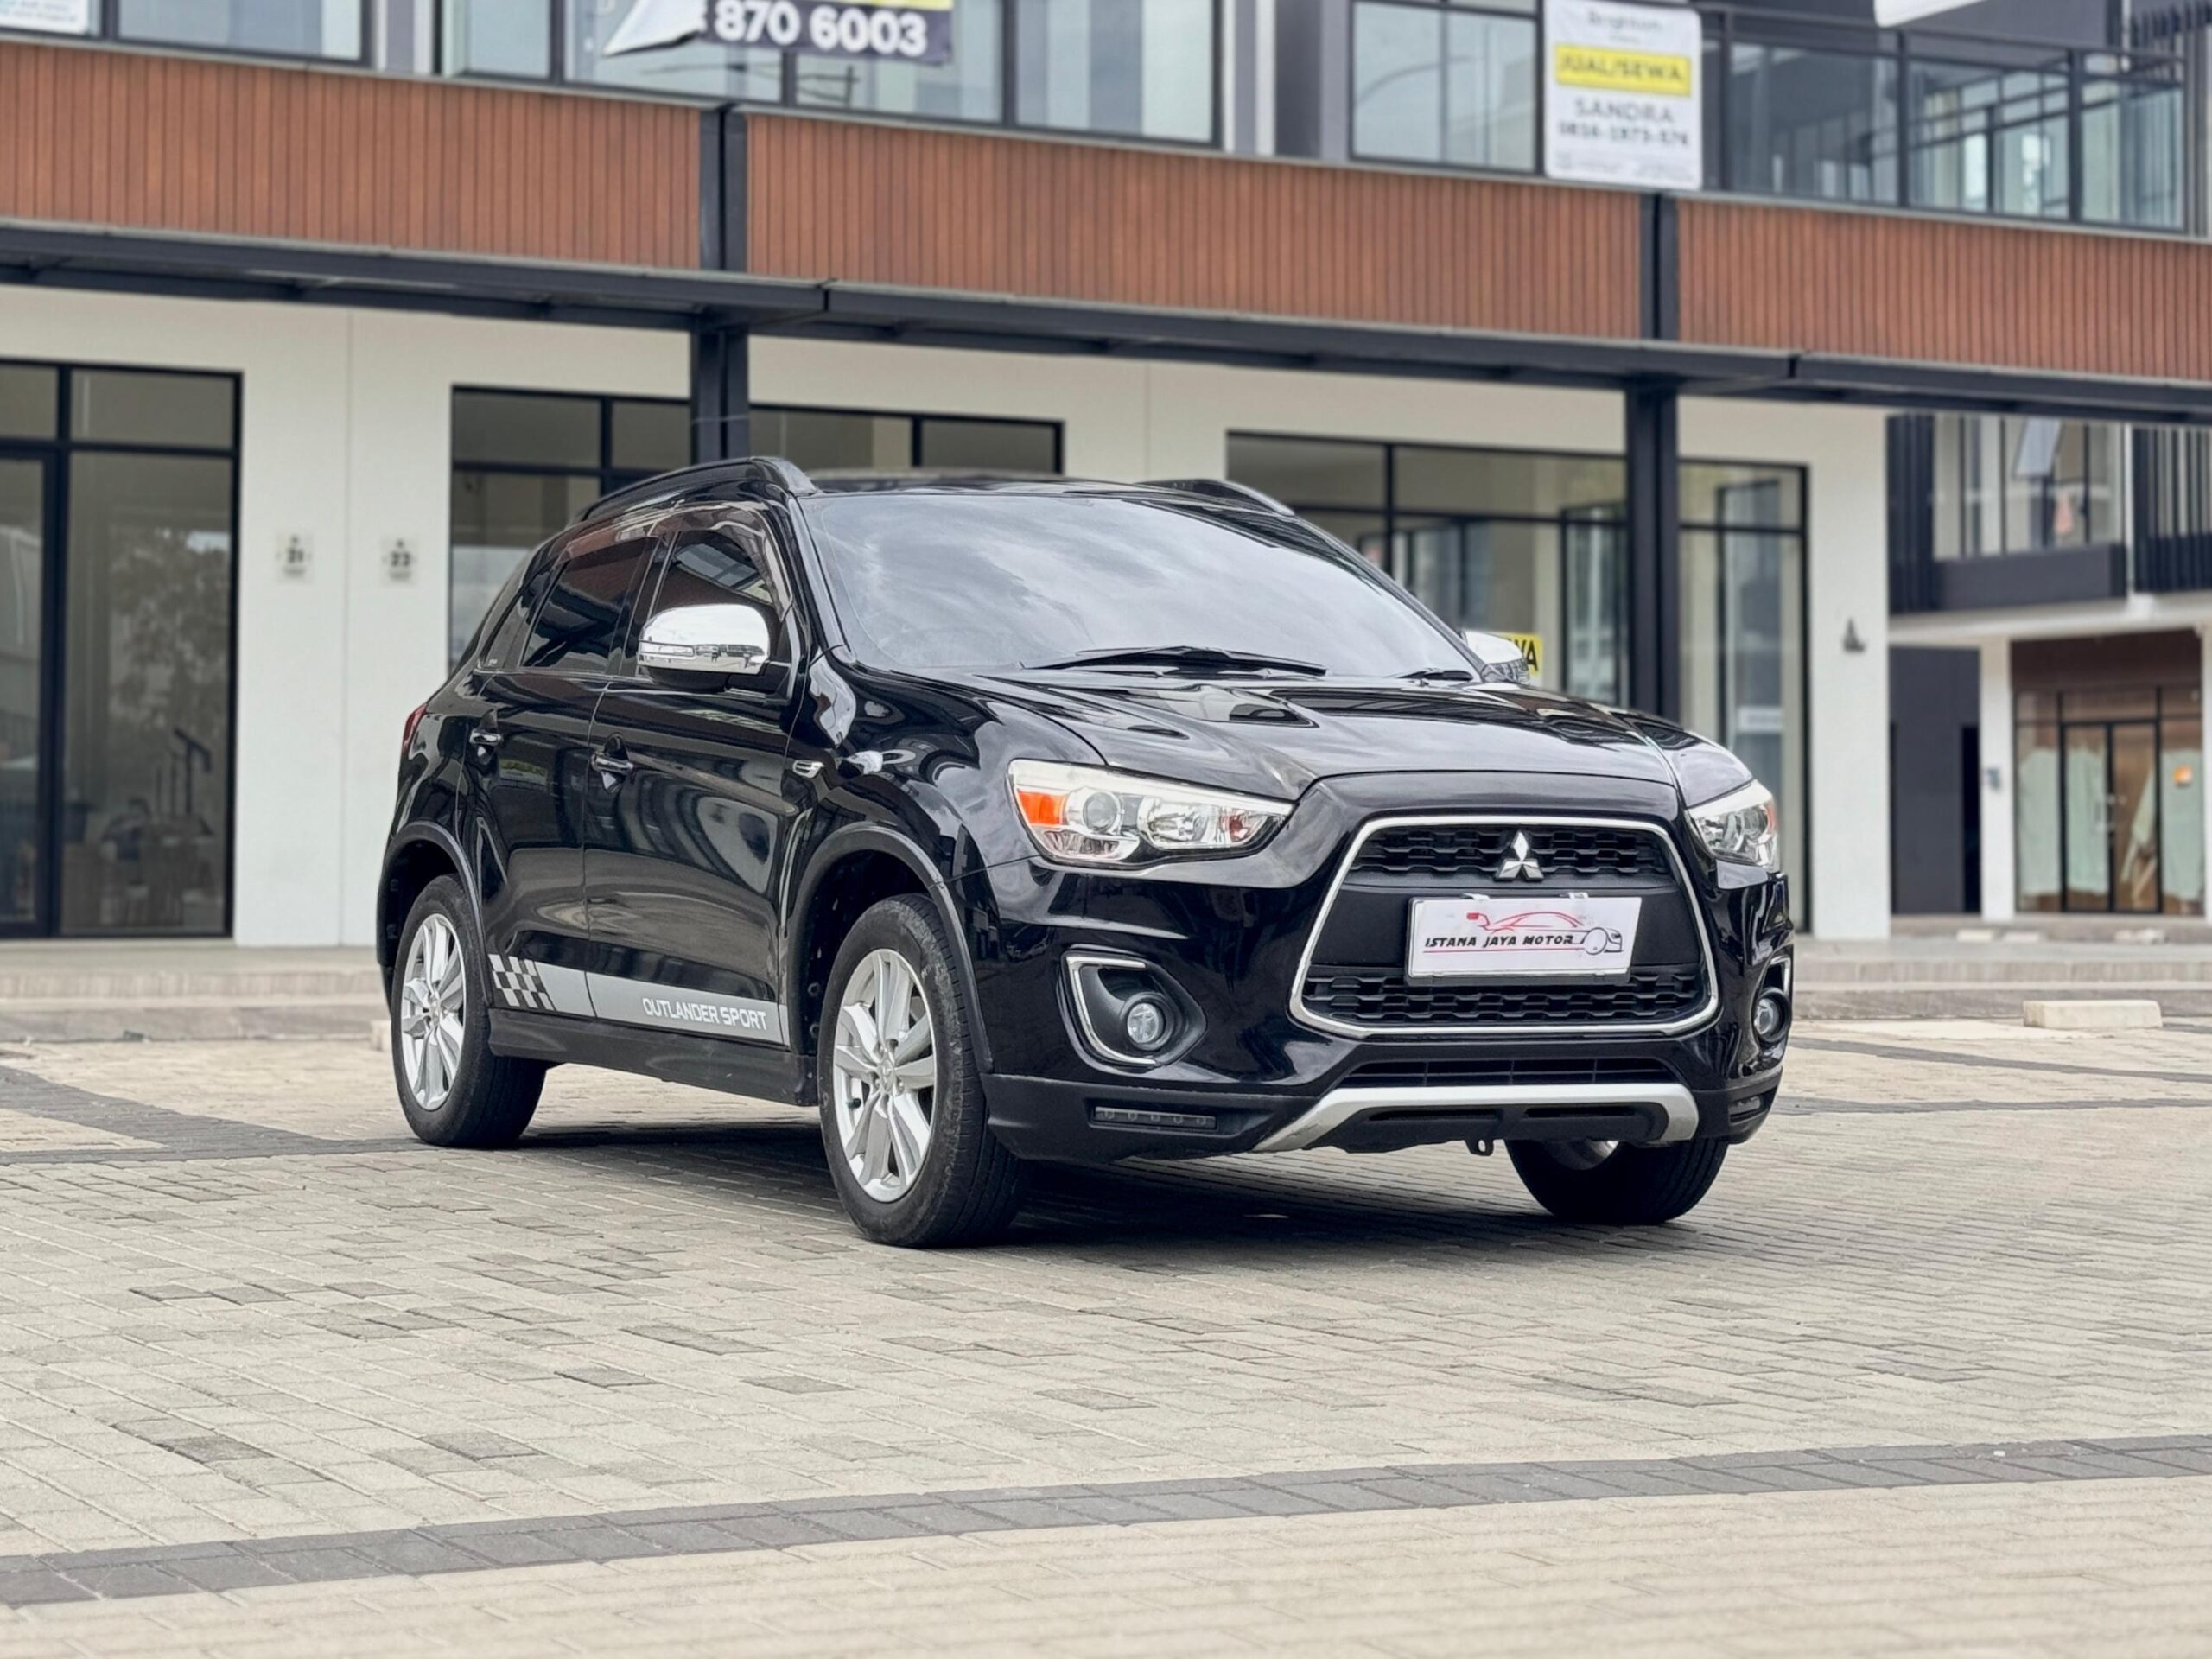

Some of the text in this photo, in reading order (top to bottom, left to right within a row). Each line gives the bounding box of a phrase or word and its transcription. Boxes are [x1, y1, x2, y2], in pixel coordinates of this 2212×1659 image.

[715, 0, 927, 56] 870 6003
[1425, 934, 1574, 948] ISTANA JAYA MOTOR
[642, 997, 767, 1031] OUTLANDER SPORT
